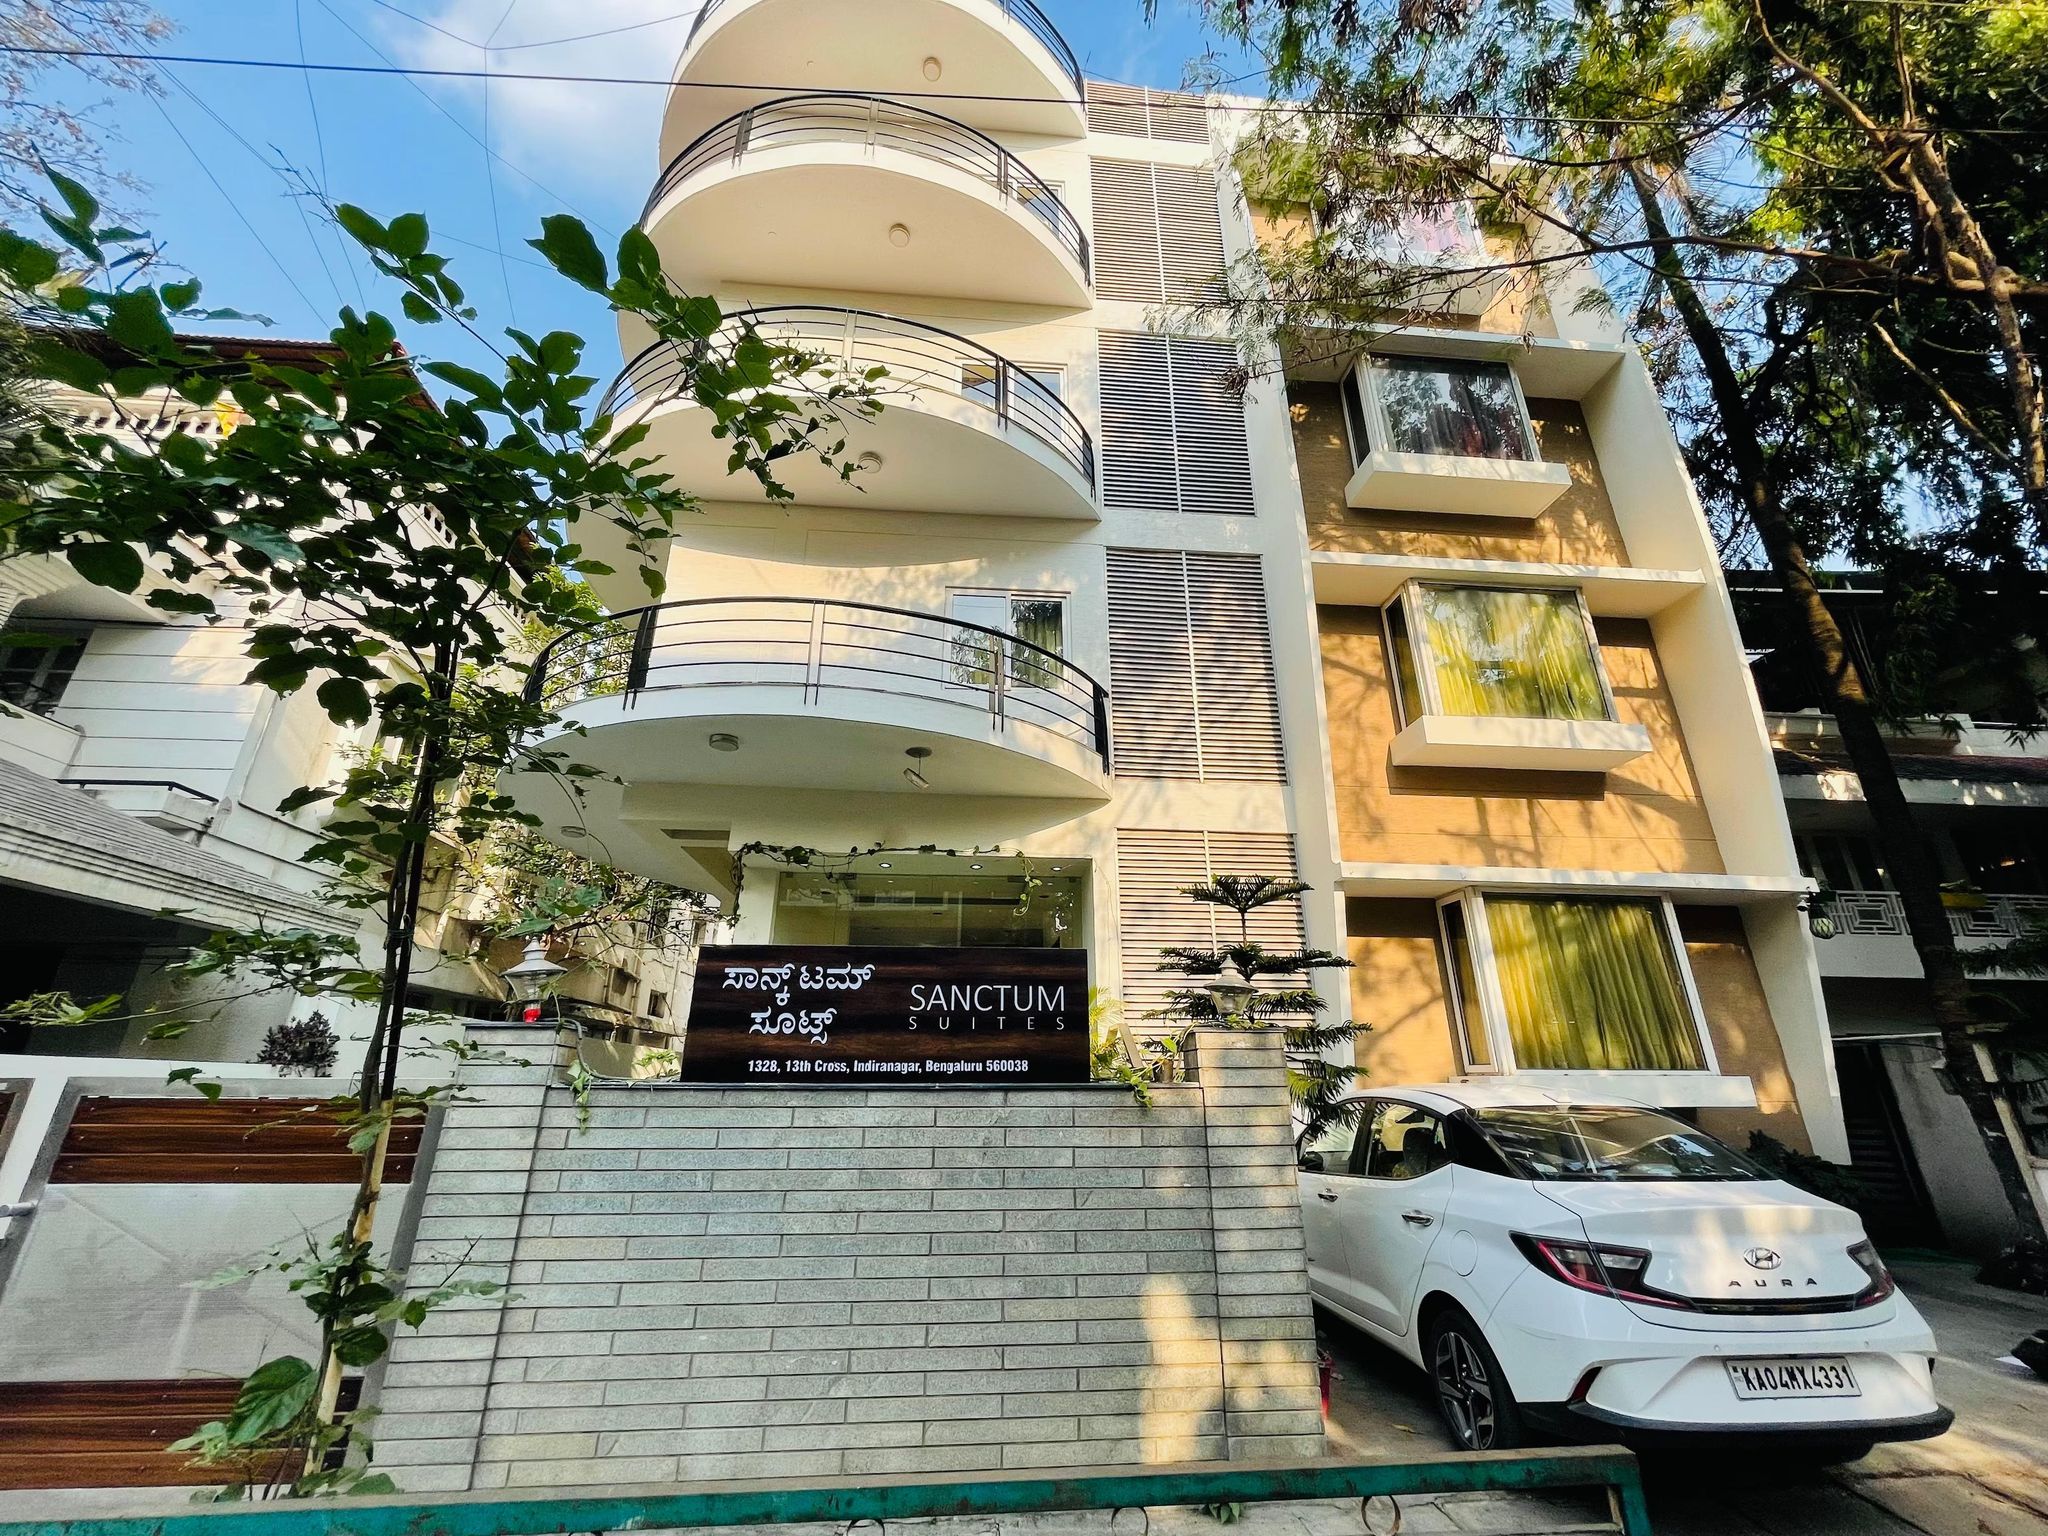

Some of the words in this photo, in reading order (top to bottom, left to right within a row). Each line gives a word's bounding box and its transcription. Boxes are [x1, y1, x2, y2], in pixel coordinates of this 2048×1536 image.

[909, 984, 1065, 1012] SANCTUM
[908, 1016, 1065, 1030] SUITES
[748, 1060, 780, 1074] 1328,
[785, 1060, 811, 1072] 13th
[814, 1060, 850, 1074] Cross,
[853, 1060, 922, 1074] Indiranagar,
[925, 1060, 982, 1074] Bengaluru
[986, 1060, 1029, 1072] 560038
[1728, 1277, 1818, 1288] AURA
